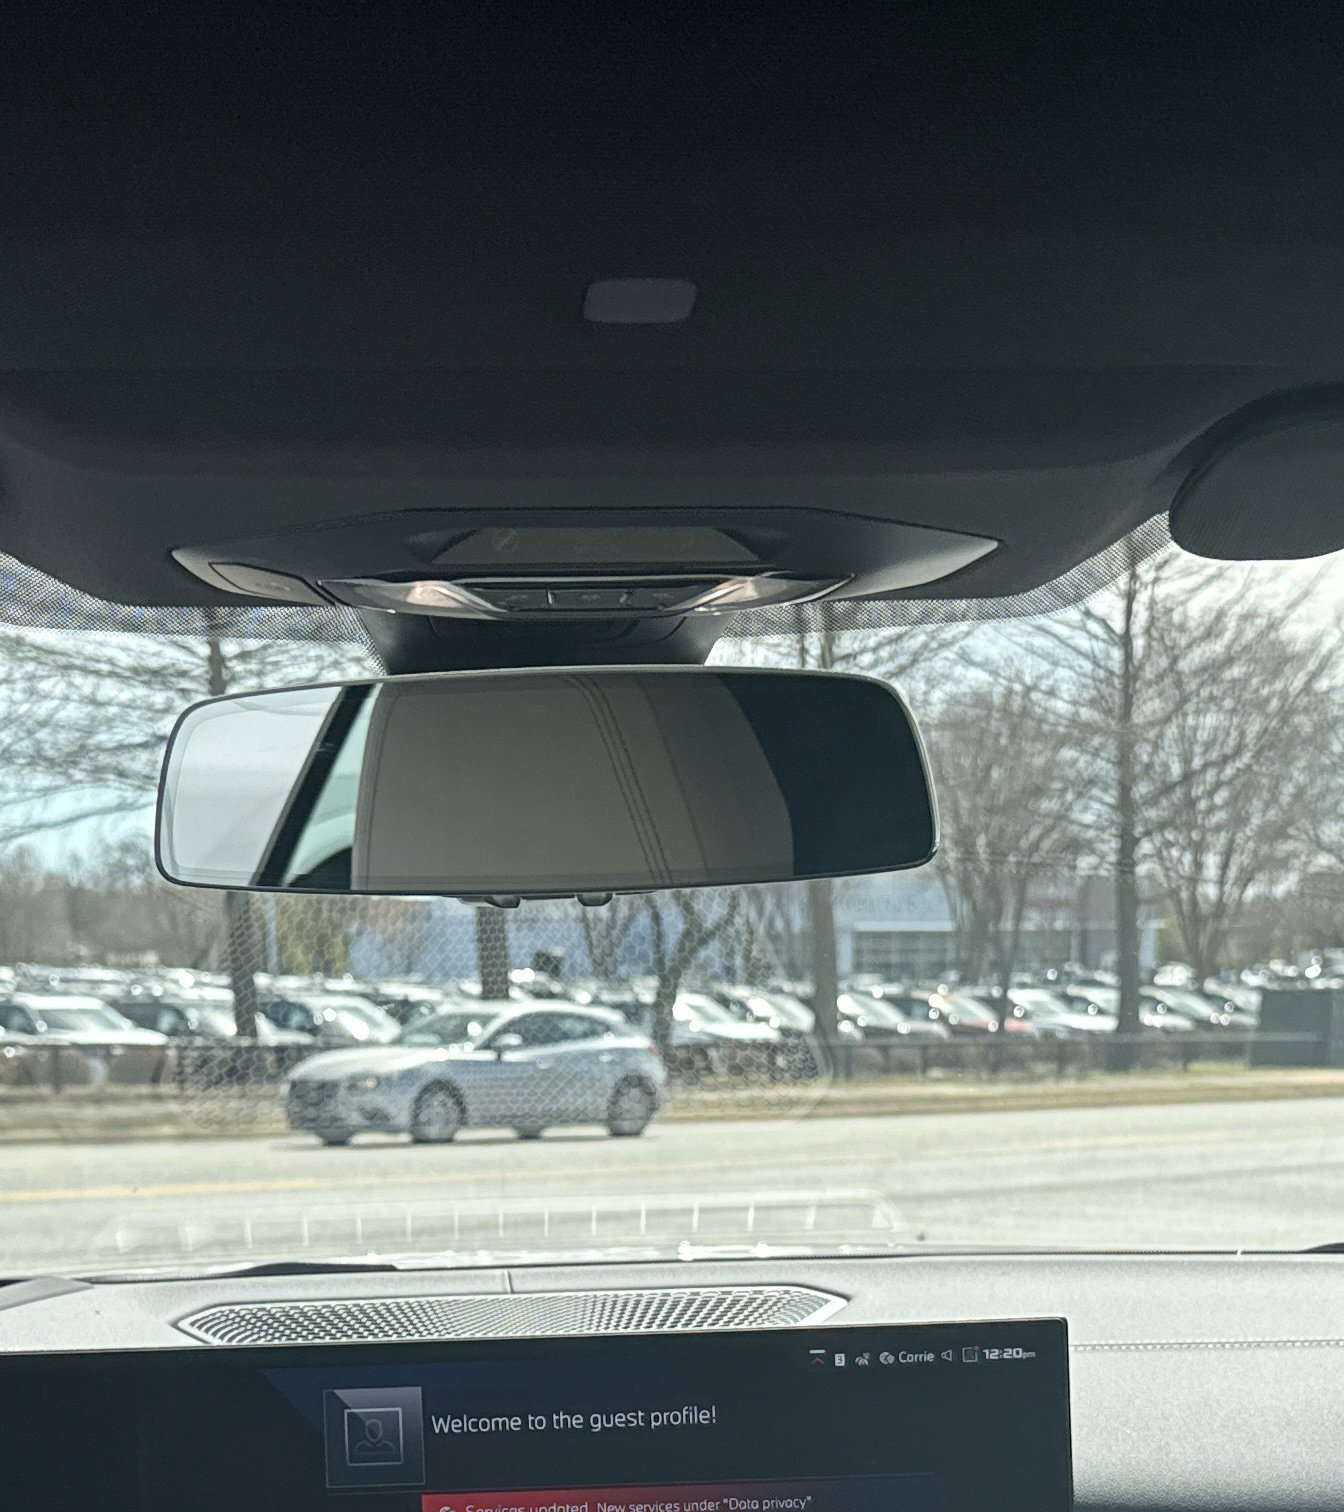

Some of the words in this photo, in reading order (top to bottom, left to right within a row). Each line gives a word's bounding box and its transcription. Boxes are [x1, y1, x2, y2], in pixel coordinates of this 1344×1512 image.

[898, 1351, 935, 1363] Corrie
[982, 1347, 1036, 1361] 12:20pm
[431, 1413, 522, 1434] Welcome
[527, 1413, 547, 1431] to
[552, 1410, 584, 1429] the
[589, 1410, 646, 1433] guest
[650, 1405, 717, 1429] profile!
[683, 1498, 721, 1512] under
[722, 1497, 760, 1511] "Data
[762, 1495, 812, 1511] privacy"
